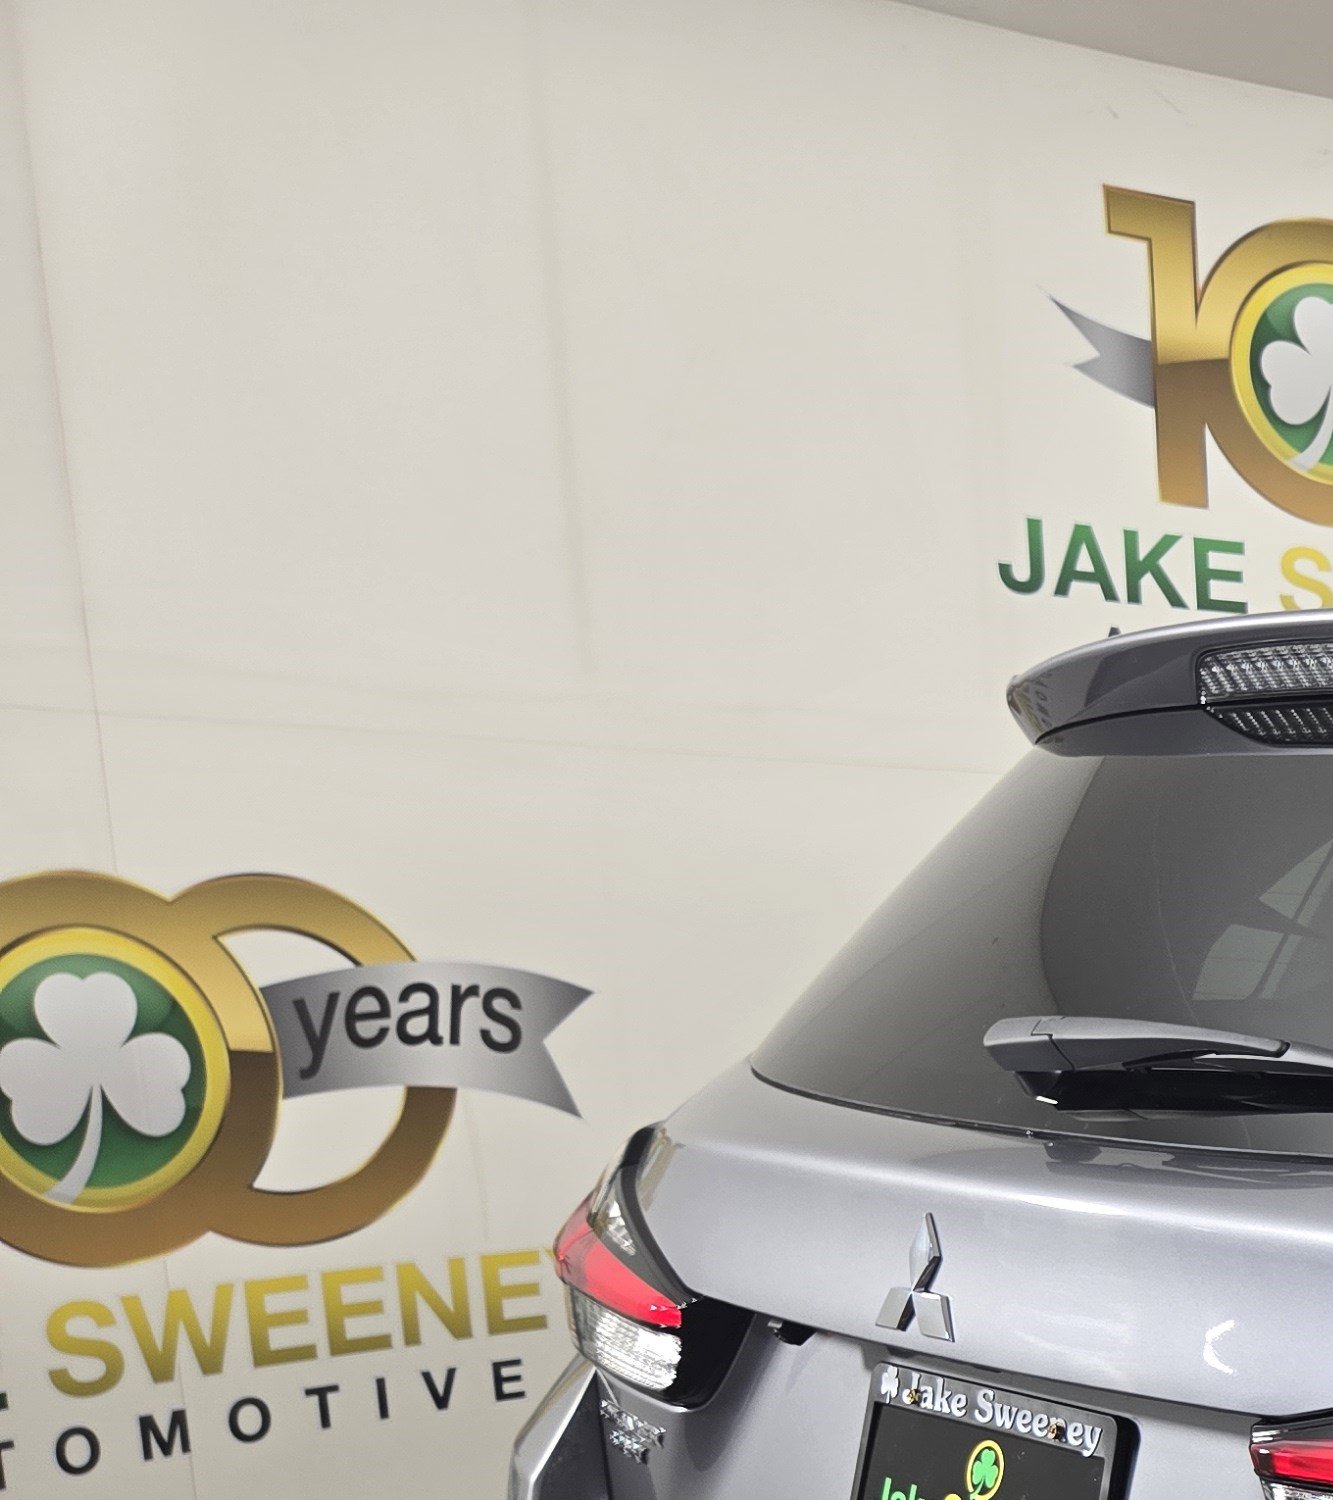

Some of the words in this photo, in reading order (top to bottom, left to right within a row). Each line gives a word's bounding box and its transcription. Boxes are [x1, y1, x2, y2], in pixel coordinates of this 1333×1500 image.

[998, 517, 1248, 614] JAKE
[293, 982, 522, 1080] years
[46, 1248, 556, 1397] SWEENE
[902, 1373, 967, 1417] Jake
